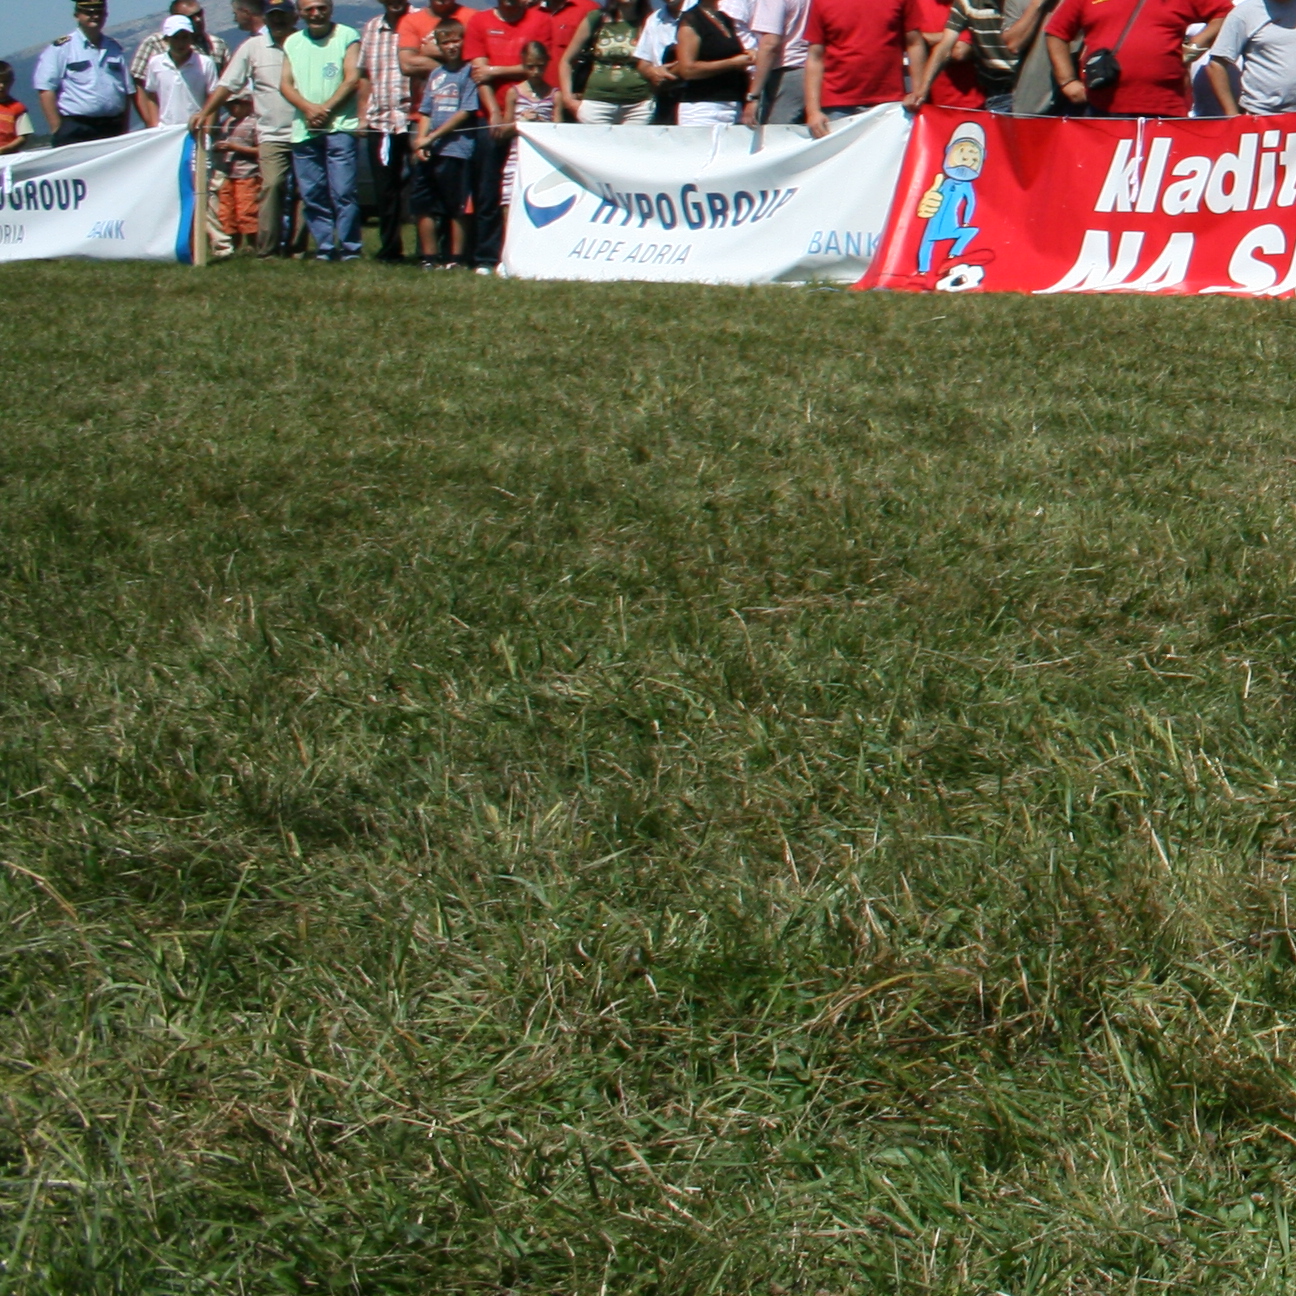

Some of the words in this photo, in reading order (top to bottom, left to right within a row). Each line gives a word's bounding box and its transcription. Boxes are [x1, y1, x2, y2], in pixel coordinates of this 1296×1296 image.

[568, 237, 625, 261] ALPE
[623, 242, 692, 265] ADRIA
[807, 230, 881, 256] BANK
